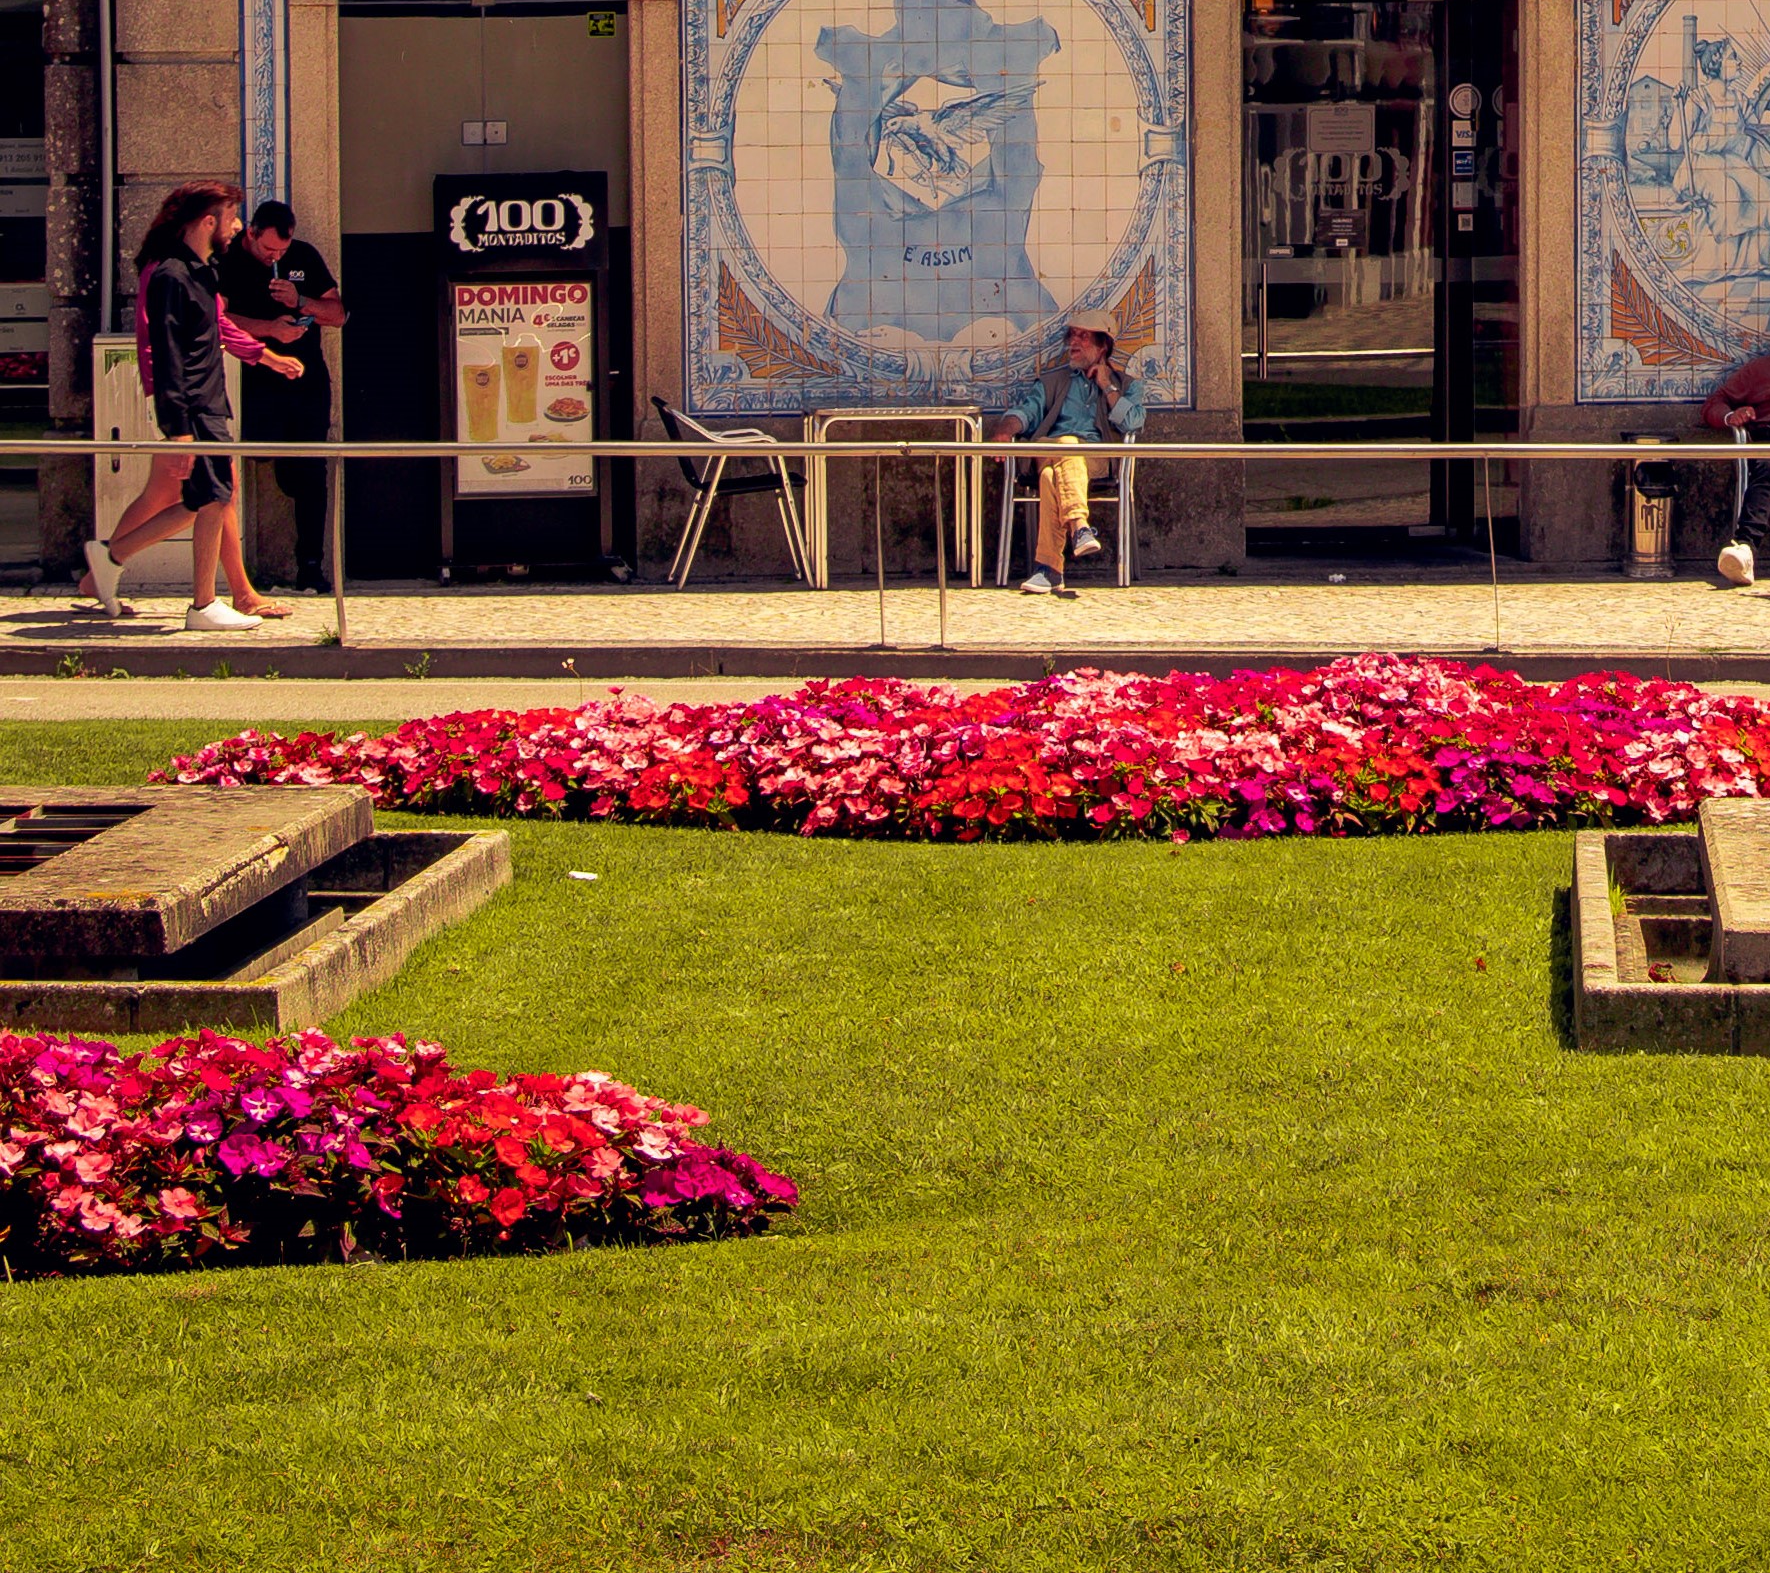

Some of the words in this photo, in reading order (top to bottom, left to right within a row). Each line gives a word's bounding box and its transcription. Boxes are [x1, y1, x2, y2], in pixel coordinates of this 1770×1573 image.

[477, 199, 565, 232] 100
[477, 232, 566, 247] MONTADITOS
[920, 246, 973, 267] ASSIM
[457, 284, 589, 307] DOMINGO
[458, 307, 525, 325] MANIA
[568, 475, 592, 485] 100
